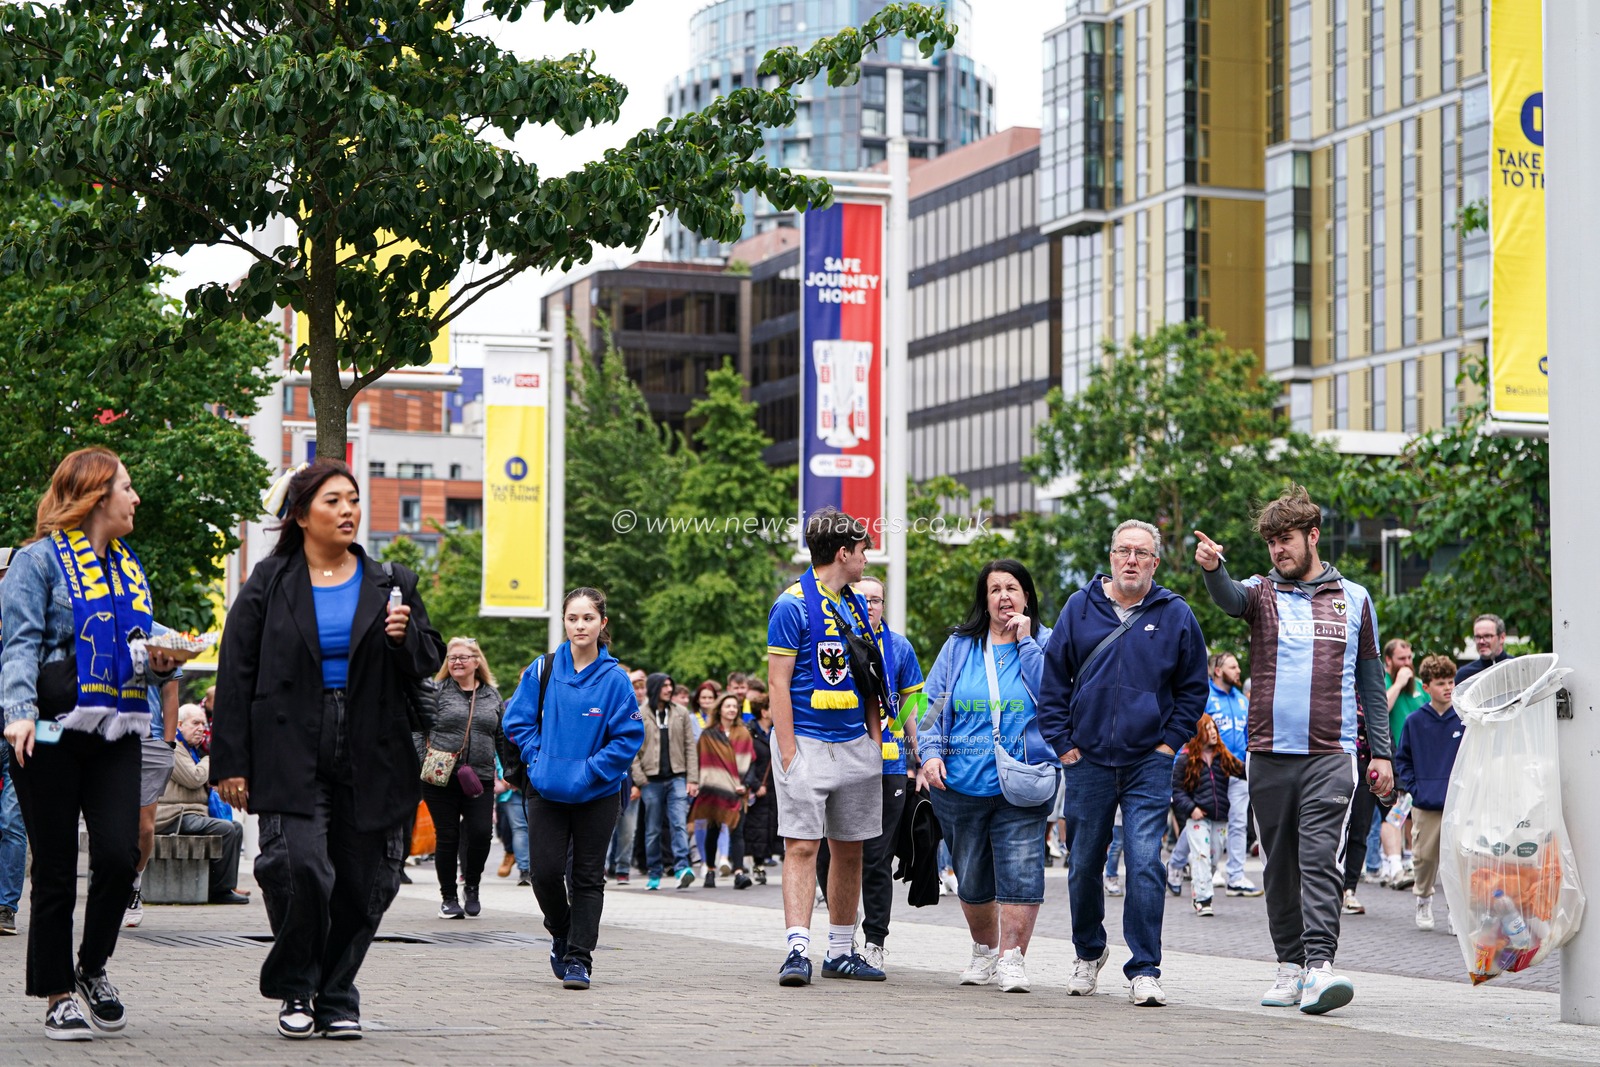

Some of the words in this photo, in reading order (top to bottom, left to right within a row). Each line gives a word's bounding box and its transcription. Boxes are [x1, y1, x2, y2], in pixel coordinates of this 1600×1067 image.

[1497, 149, 1541, 170] TAKE
[1501, 169, 1524, 187] TO
[824, 256, 861, 273] SAFE
[805, 271, 879, 289] JOURNEY
[818, 288, 866, 304] HOME
[491, 374, 511, 387] sky
[491, 484, 515, 493] TAKE
[518, 484, 540, 494] TIME
[493, 493, 506, 503] TO
[510, 493, 539, 503] THINK
[60, 551, 82, 598] LEAGUE
[1281, 622, 1312, 635] WAR
[1316, 625, 1344, 637] child
